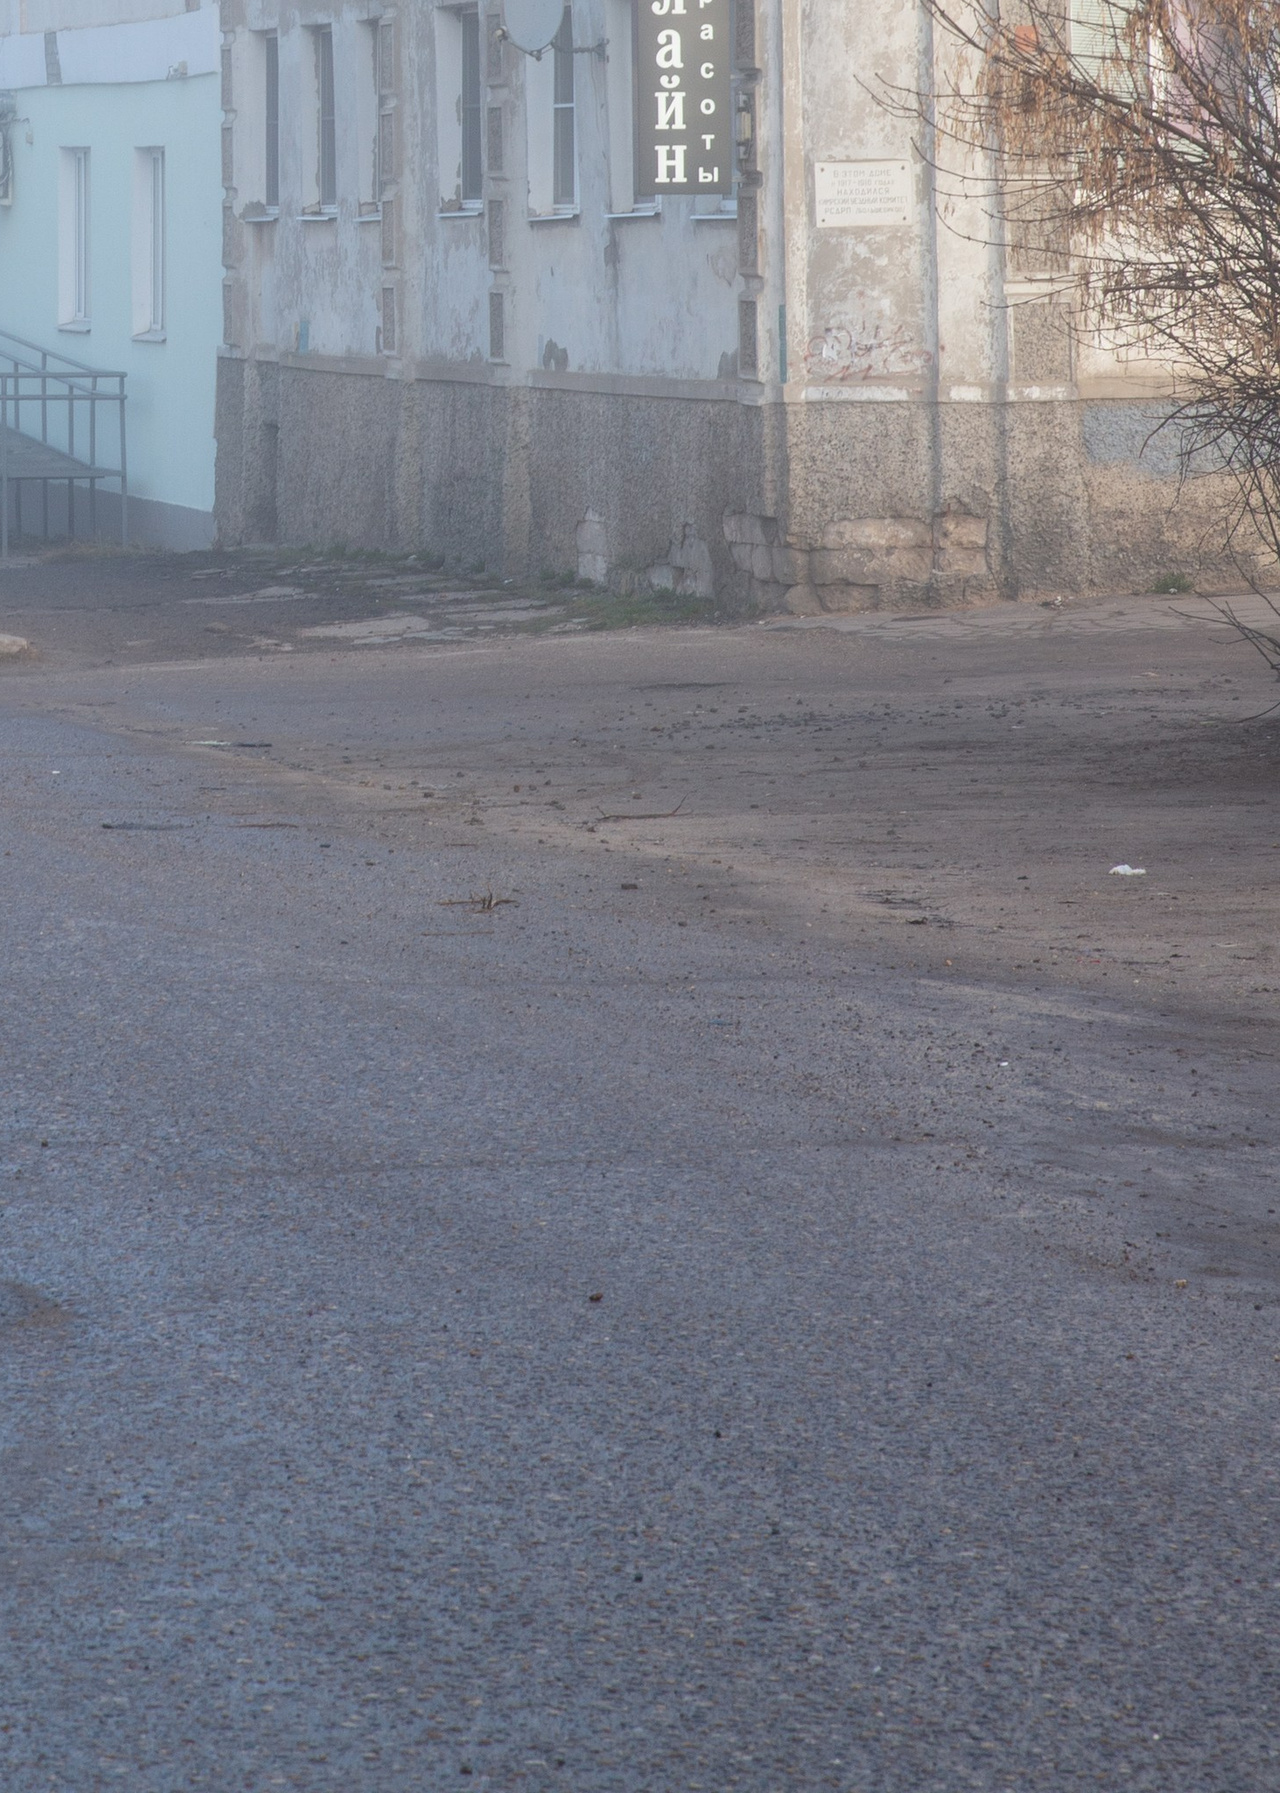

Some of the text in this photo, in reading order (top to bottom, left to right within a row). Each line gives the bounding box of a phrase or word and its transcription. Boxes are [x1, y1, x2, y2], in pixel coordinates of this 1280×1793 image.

[841, 169, 866, 178] ЭТОМ
[869, 168, 892, 178] ДОМЕ
[836, 187, 890, 196] НАХОДИЛСЯ
[824, 207, 852, 215] РСДРП
